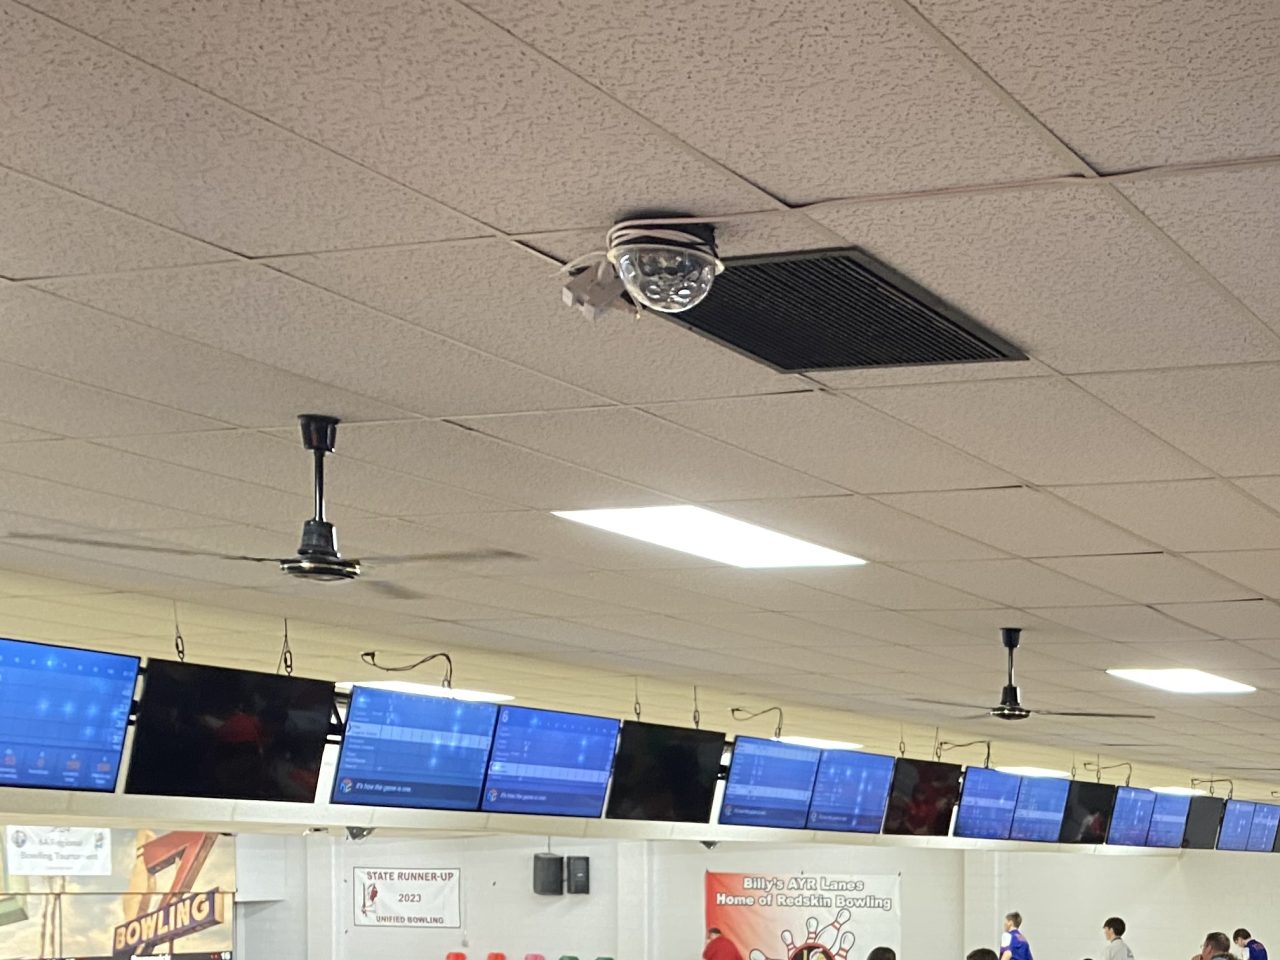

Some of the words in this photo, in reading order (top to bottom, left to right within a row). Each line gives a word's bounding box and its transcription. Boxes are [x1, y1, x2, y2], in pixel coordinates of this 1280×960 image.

[367, 871, 394, 881] STATE
[397, 872, 454, 882] RUNNER-UP
[743, 877, 784, 892] Billy's
[787, 878, 817, 890] AYR
[820, 877, 864, 891] Lanes
[398, 893, 421, 903] 2023
[716, 893, 754, 906] Home
[758, 893, 773, 906] of
[776, 894, 832, 908] Redskin
[835, 895, 892, 911] Bowling
[115, 892, 209, 950] BOWLING
[407, 916, 444, 924] BOWLING
